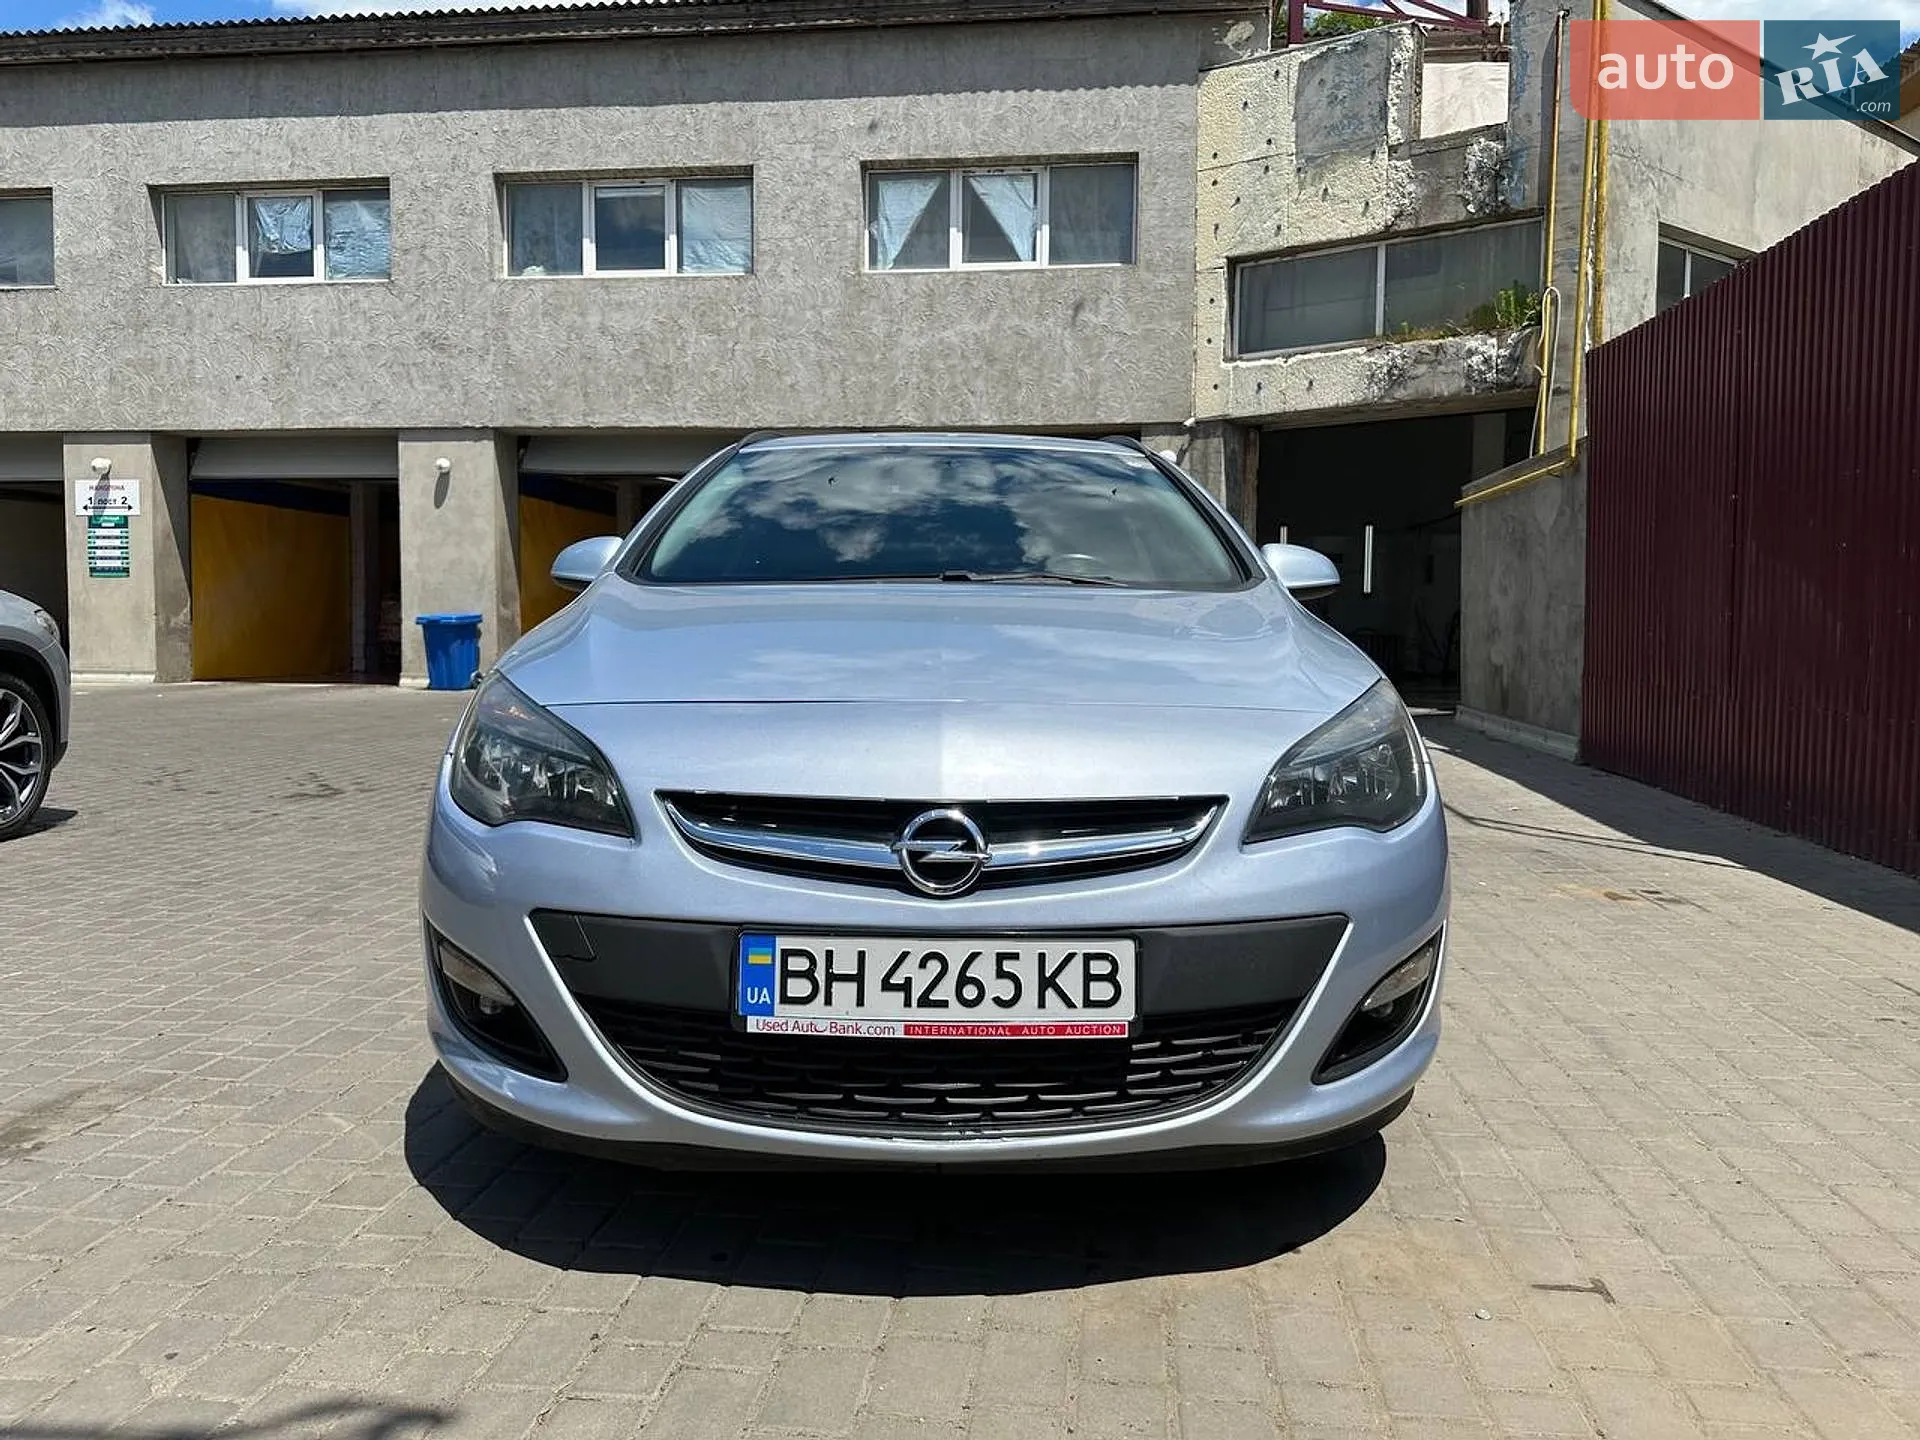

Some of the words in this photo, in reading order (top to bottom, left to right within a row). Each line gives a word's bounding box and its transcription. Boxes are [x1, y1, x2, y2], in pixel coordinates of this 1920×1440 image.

[121, 496, 128, 505] 2
[779, 949, 867, 1007] BH
[881, 950, 1023, 1009] 4265
[1037, 952, 1122, 1009] KB
[747, 987, 771, 1004] UA
[756, 1019, 788, 1032] Used
[909, 1025, 1011, 1036] INTERNATIONAL
[1022, 1026, 1056, 1035] AUTO
[1065, 1024, 1121, 1035] AUCTION
